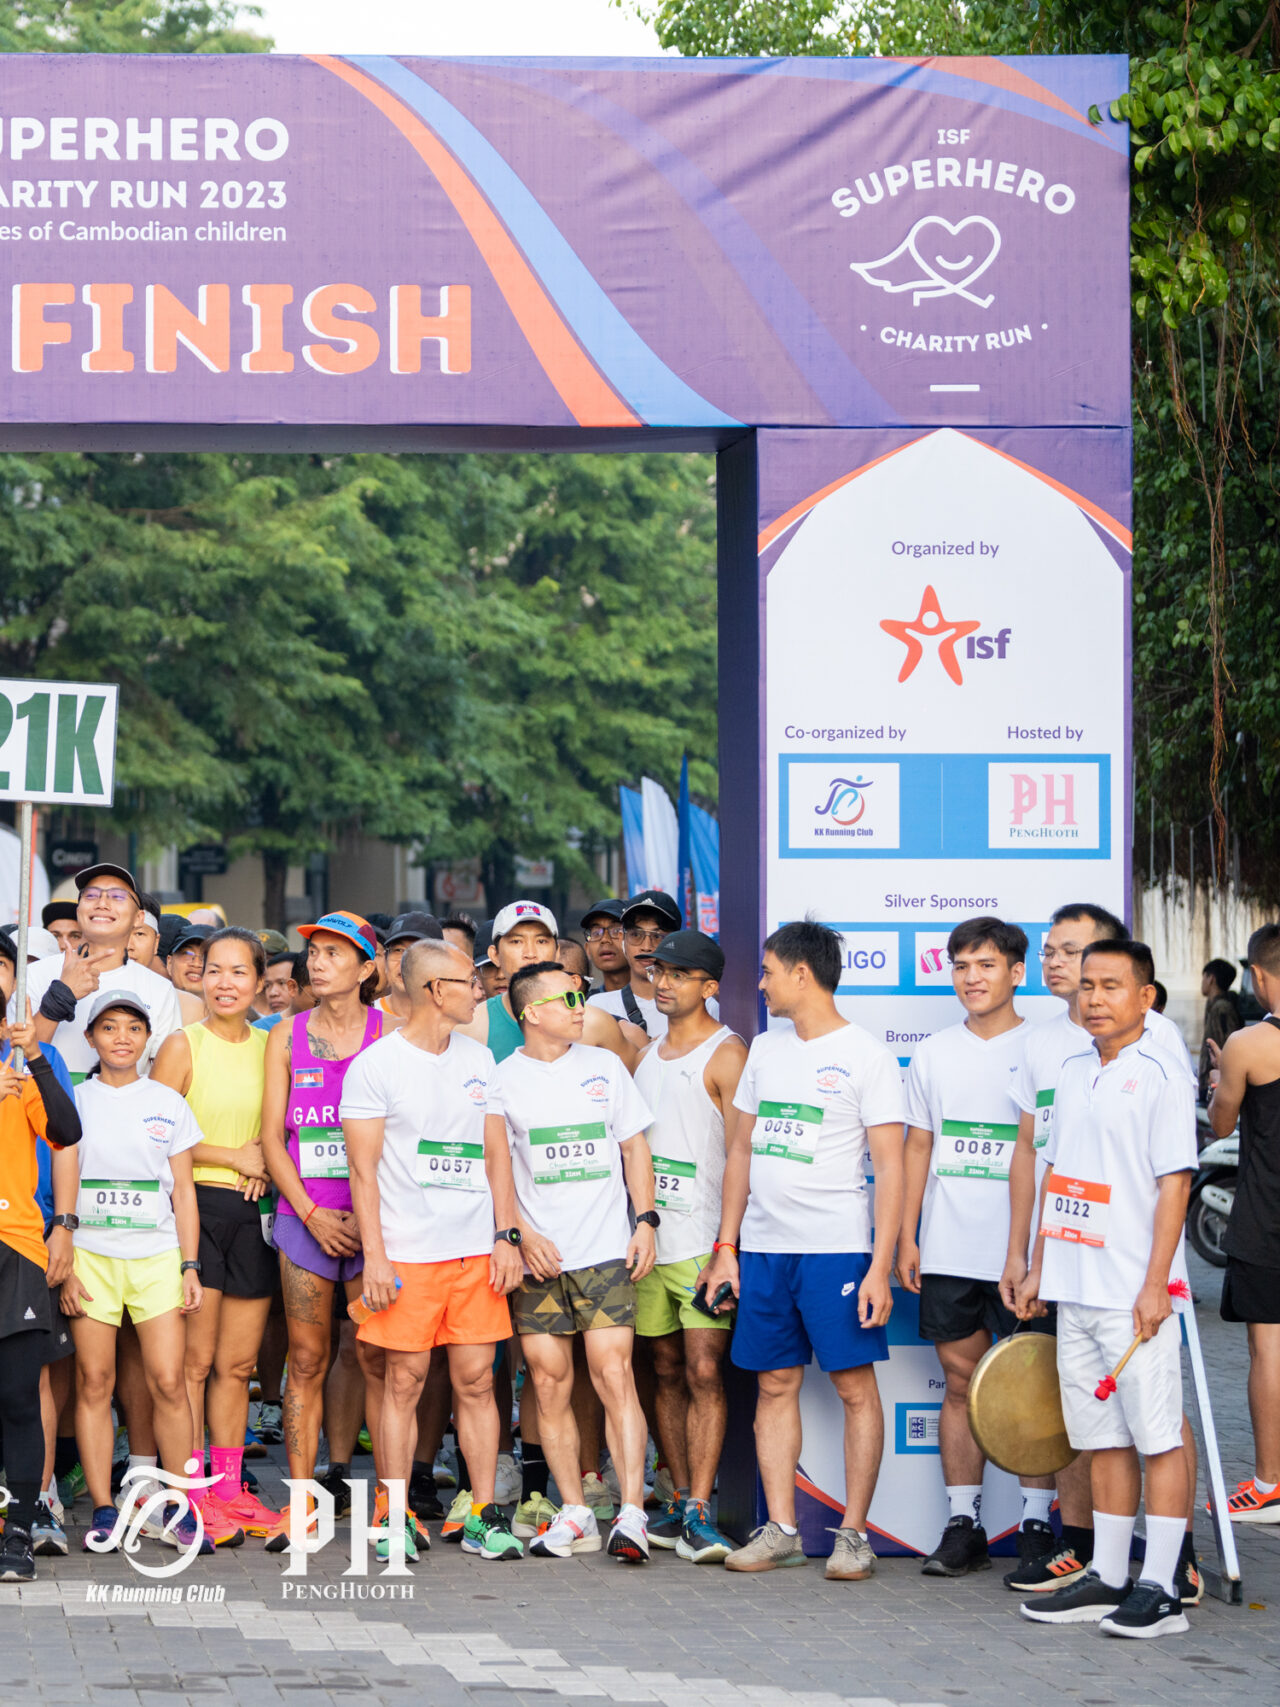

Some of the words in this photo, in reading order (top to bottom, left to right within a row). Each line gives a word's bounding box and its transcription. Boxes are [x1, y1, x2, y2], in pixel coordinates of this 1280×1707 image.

[937, 128, 970, 145] ISF
[110, 180, 188, 208] RUN
[200, 180, 287, 209] 2023
[831, 157, 1076, 218] SUPERHERO
[28, 220, 54, 241] of
[59, 220, 188, 241] Cambodian
[194, 220, 287, 242] children
[880, 326, 980, 352] CHARITY
[985, 325, 1032, 350] RUN
[891, 541, 975, 558] Organized
[980, 541, 999, 558] by
[966, 628, 1012, 659] isf
[784, 725, 885, 741] Co-organized
[889, 726, 907, 742] by
[1007, 725, 1062, 739] Hosted
[1065, 726, 1084, 741] by
[1009, 773, 1078, 825] PH
[814, 828, 824, 836] KK
[825, 828, 854, 837] Running
[856, 828, 874, 836] Club
[884, 894, 926, 908] Silver
[930, 895, 999, 911] Sponsors
[293, 1105, 342, 1125] GAR
[764, 1119, 805, 1137] 0055
[545, 1142, 595, 1160] 0020
[954, 1139, 1005, 1156] 0087
[429, 1157, 472, 1174] 0057
[654, 1175, 680, 1192] 52
[96, 1191, 143, 1207] 0136
[1055, 1197, 1090, 1219] 0122
